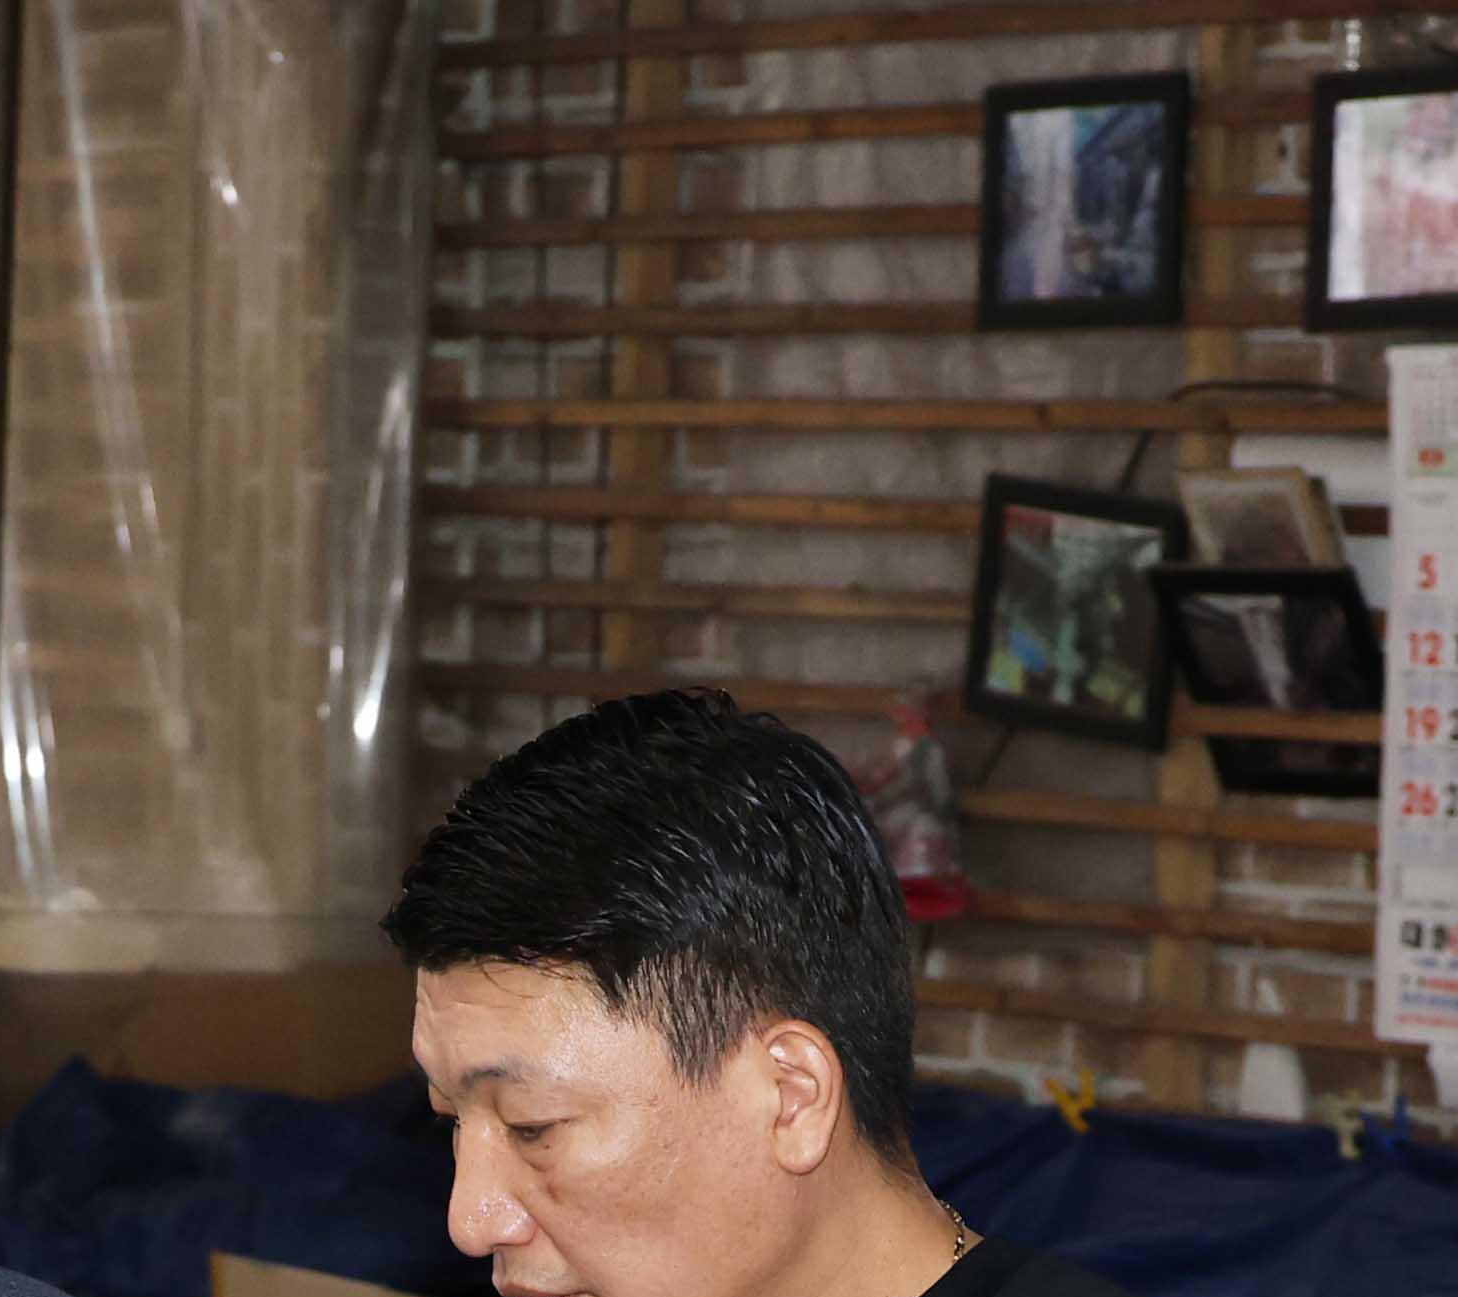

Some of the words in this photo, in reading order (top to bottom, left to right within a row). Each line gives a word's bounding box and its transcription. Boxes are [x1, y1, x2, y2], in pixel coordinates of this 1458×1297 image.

[1417, 553, 1438, 590] 5
[1408, 630, 1443, 667] 12
[1405, 705, 1440, 740] 19
[1402, 780, 1438, 817] 26
